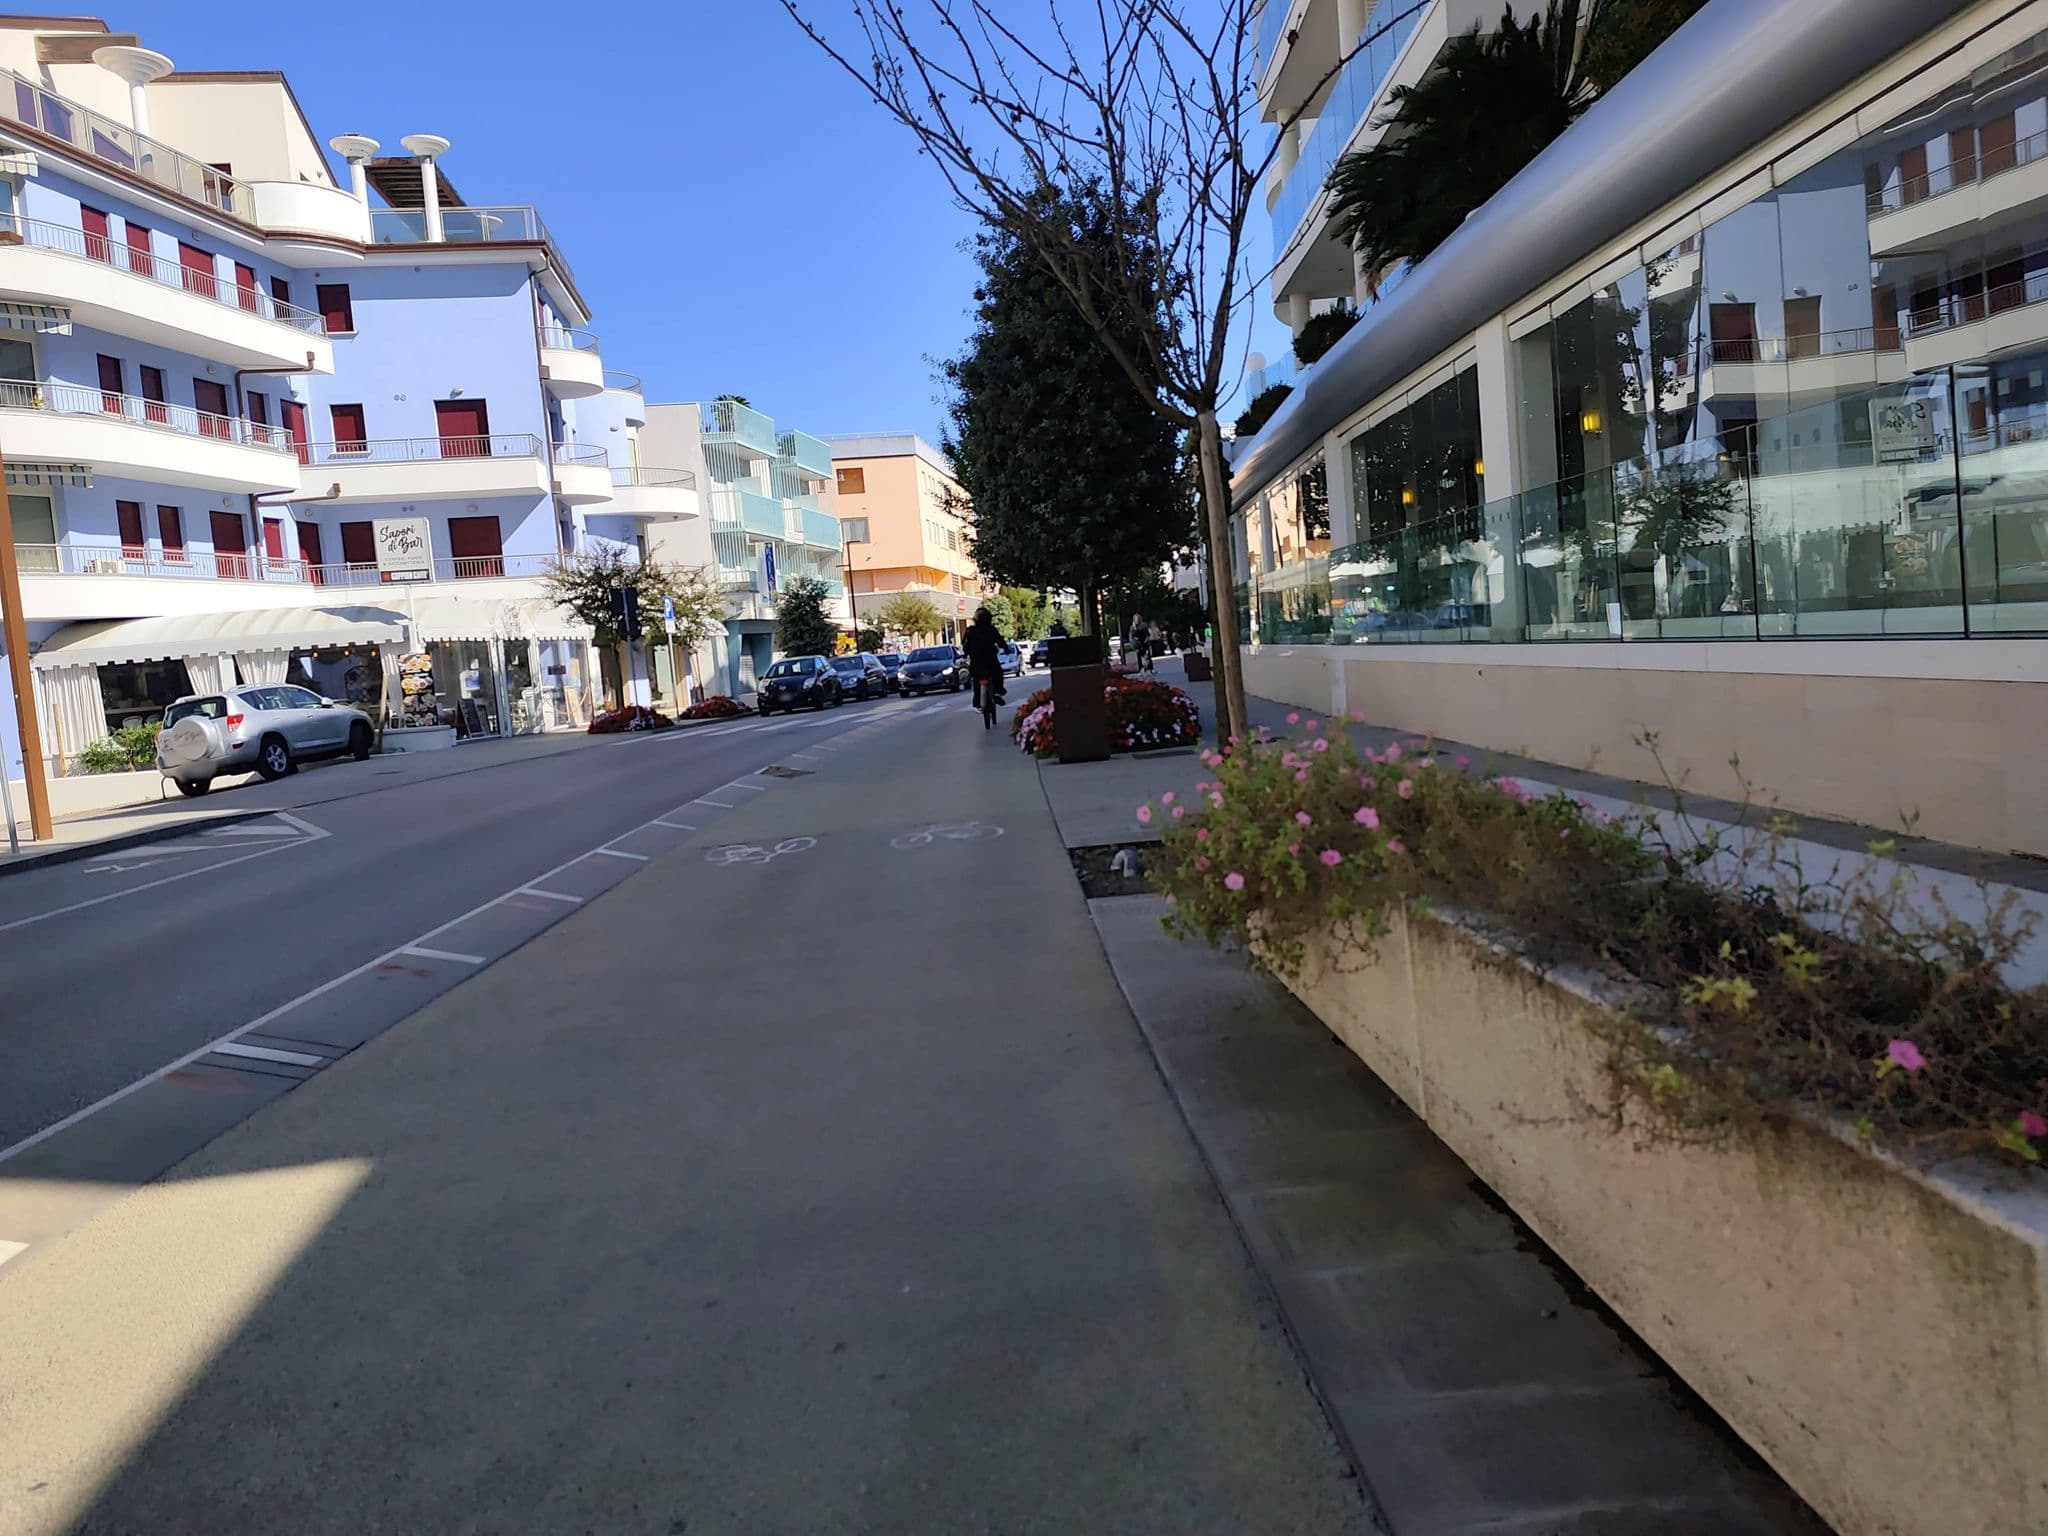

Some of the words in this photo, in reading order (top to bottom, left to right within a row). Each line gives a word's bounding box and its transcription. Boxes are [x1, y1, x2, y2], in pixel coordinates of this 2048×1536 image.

[380, 525, 415, 543] Sapori
[387, 539, 397, 553] di
[398, 536, 424, 554] Bar
[664, 598, 671, 618] P
